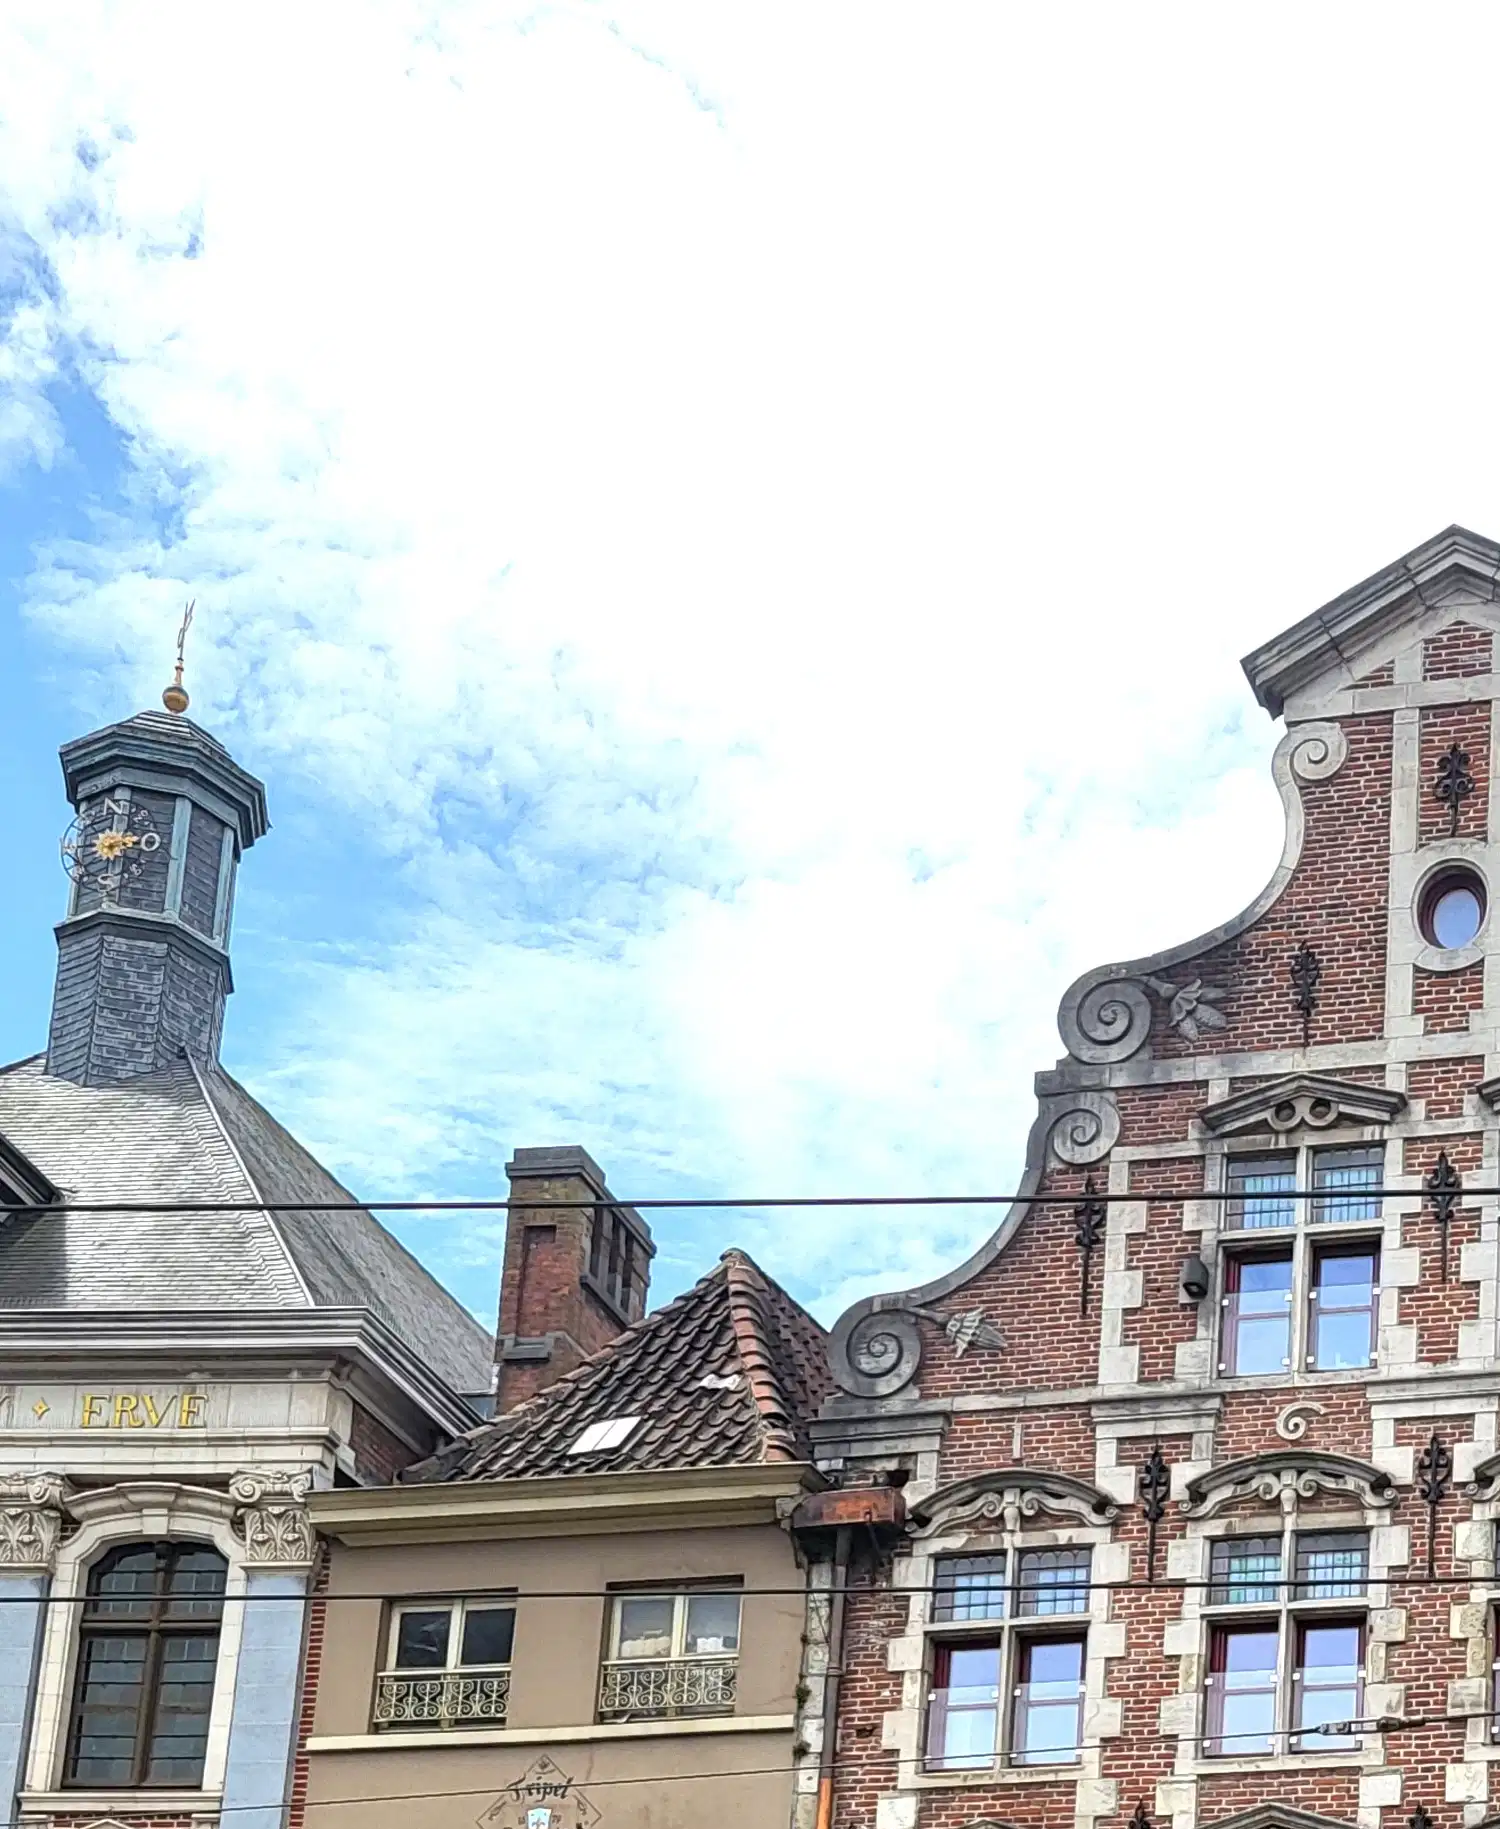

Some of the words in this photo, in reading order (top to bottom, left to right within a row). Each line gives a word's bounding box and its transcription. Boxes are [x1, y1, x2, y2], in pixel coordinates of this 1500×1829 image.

[103, 797, 129, 815] N
[140, 832, 161, 852] O
[79, 1393, 208, 1429] ERVE
[506, 1772, 575, 1803] Tripel
